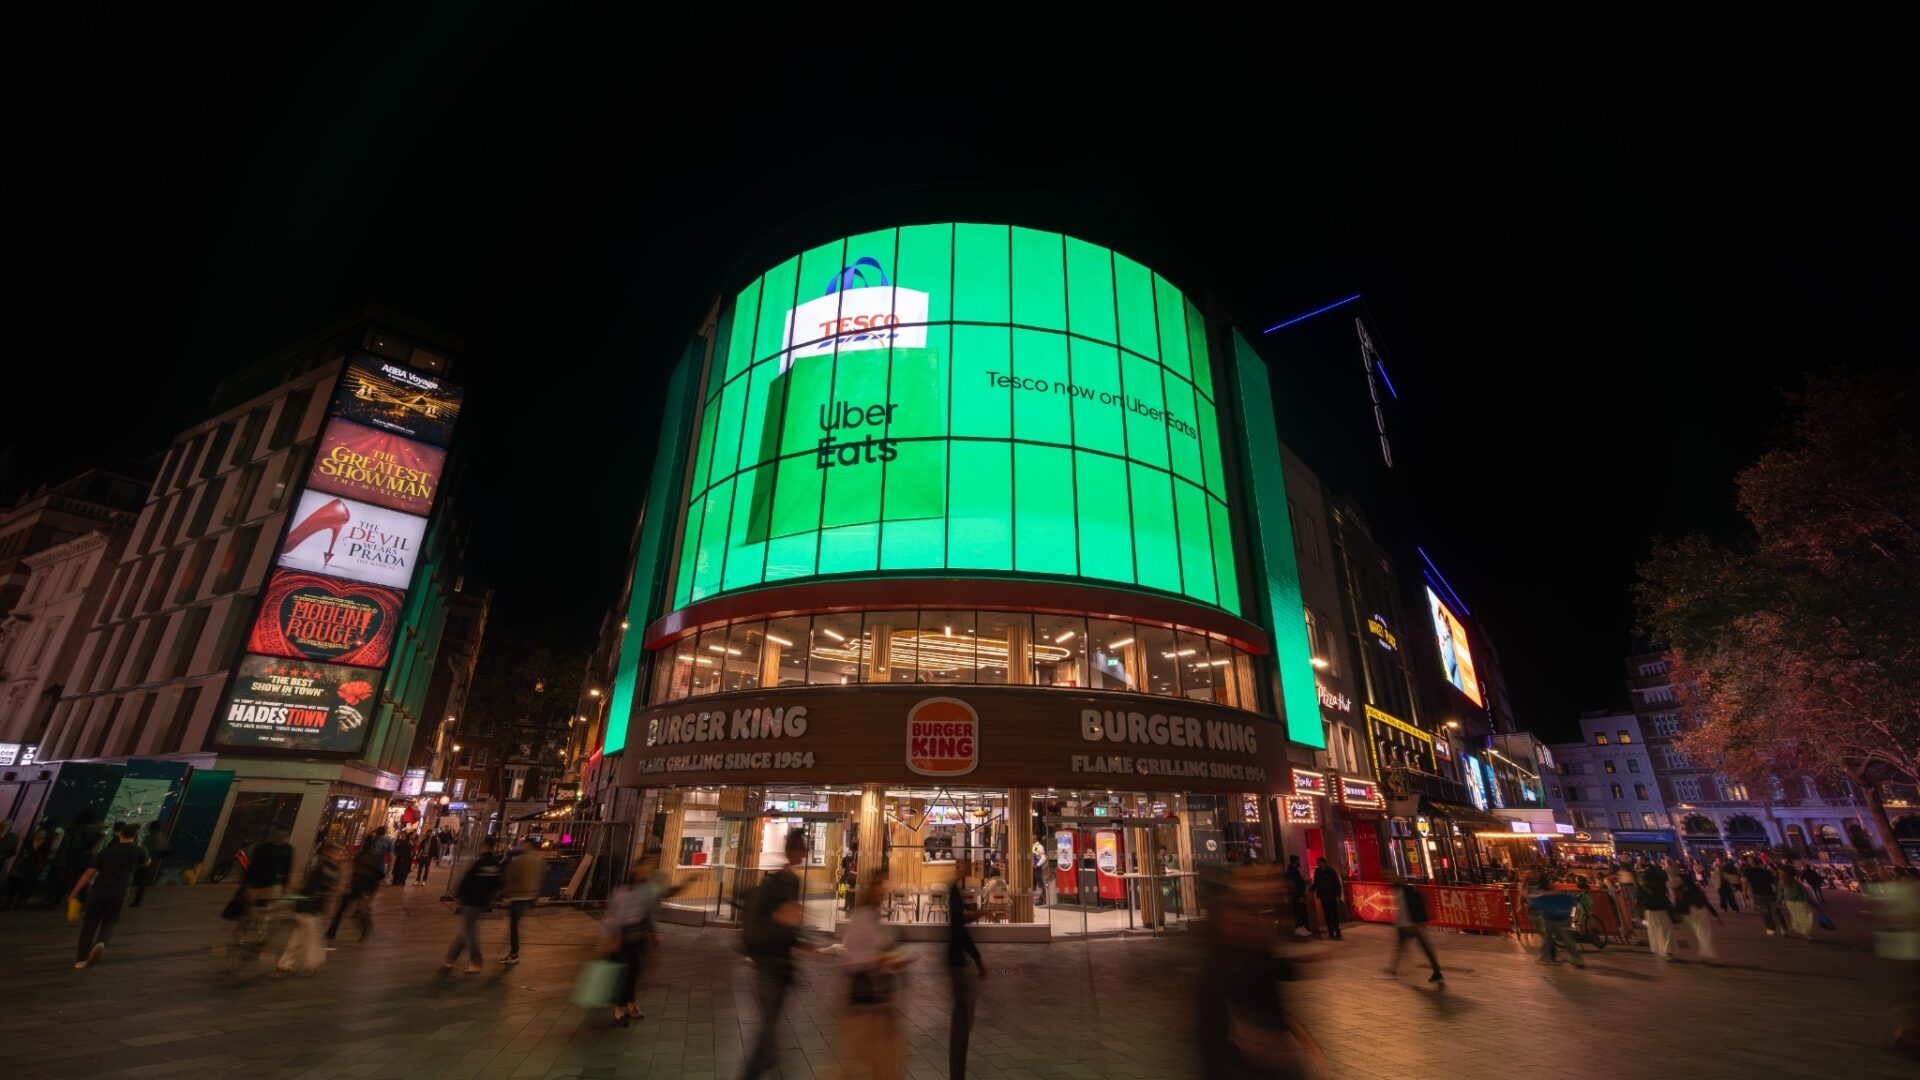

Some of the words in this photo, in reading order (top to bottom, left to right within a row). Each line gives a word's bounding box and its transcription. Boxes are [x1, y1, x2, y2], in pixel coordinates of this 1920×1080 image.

[819, 314, 899, 338] TESCO
[381, 364, 407, 378] ABBA
[408, 373, 438, 389] Voyage
[819, 401, 898, 431] Uber
[985, 371, 1048, 392] Tesco
[1054, 381, 1095, 400] now
[1100, 391, 1124, 408] on
[1126, 394, 1164, 422] Uber
[1165, 410, 1197, 440] Eats
[373, 449, 397, 463] THE
[816, 434, 897, 469] Eats
[331, 446, 431, 485] GREATEST
[320, 458, 432, 498] SHOWMAN
[360, 521, 379, 531] THE
[348, 527, 409, 551] DEVIL
[349, 542, 404, 567] PRADA
[291, 600, 361, 627] MOULIN
[251, 681, 281, 692] SHOW
[282, 684, 293, 694] IN
[290, 678, 314, 687] BEST
[1318, 685, 1338, 709] Pizza
[1338, 692, 1352, 713] Hut
[228, 704, 328, 728] HADESTOWN
[646, 711, 726, 747] BURGER
[730, 705, 807, 740] KING
[911, 722, 973, 737] BURGER
[1081, 709, 1204, 748] BURGER
[1205, 719, 1257, 754] KING
[911, 738, 973, 758] KING
[666, 753, 724, 772] GRILLING
[724, 752, 772, 769] SINCE
[774, 751, 815, 769] 1954
[1071, 755, 1134, 774] FLAME
[1135, 757, 1208, 778] GRILLING
[1210, 762, 1244, 781] SINCE
[1244, 766, 1266, 783] 1954
[1439, 888, 1467, 909] EAT
[1443, 907, 1471, 926] HOT
